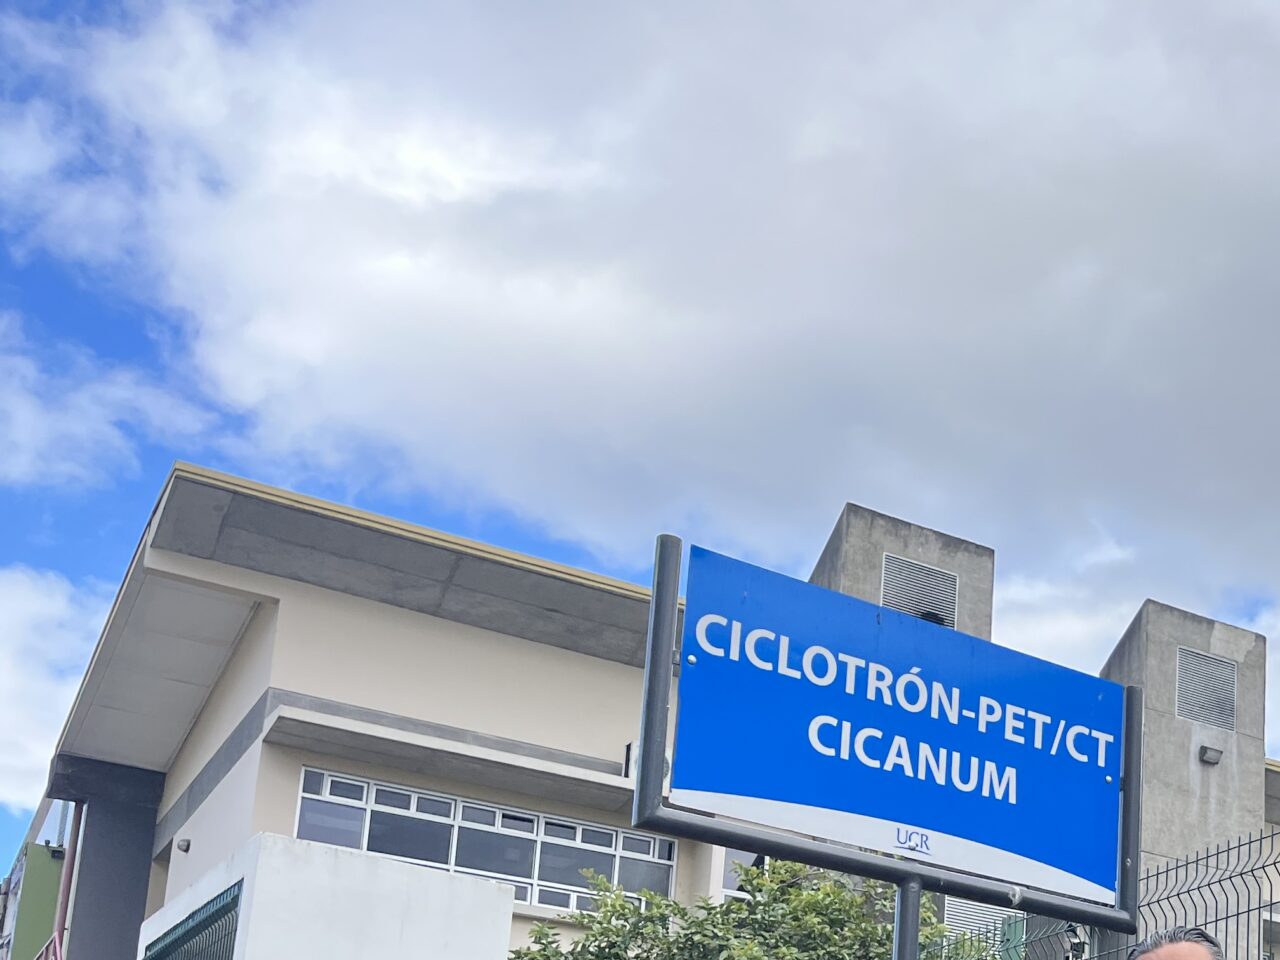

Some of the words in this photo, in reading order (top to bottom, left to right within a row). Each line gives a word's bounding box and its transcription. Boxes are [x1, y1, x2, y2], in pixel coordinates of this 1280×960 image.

[695, 613, 1114, 768] CICLOTRÓN-PET/CT
[808, 715, 1017, 805] CICANUM
[896, 827, 930, 851] UCR
